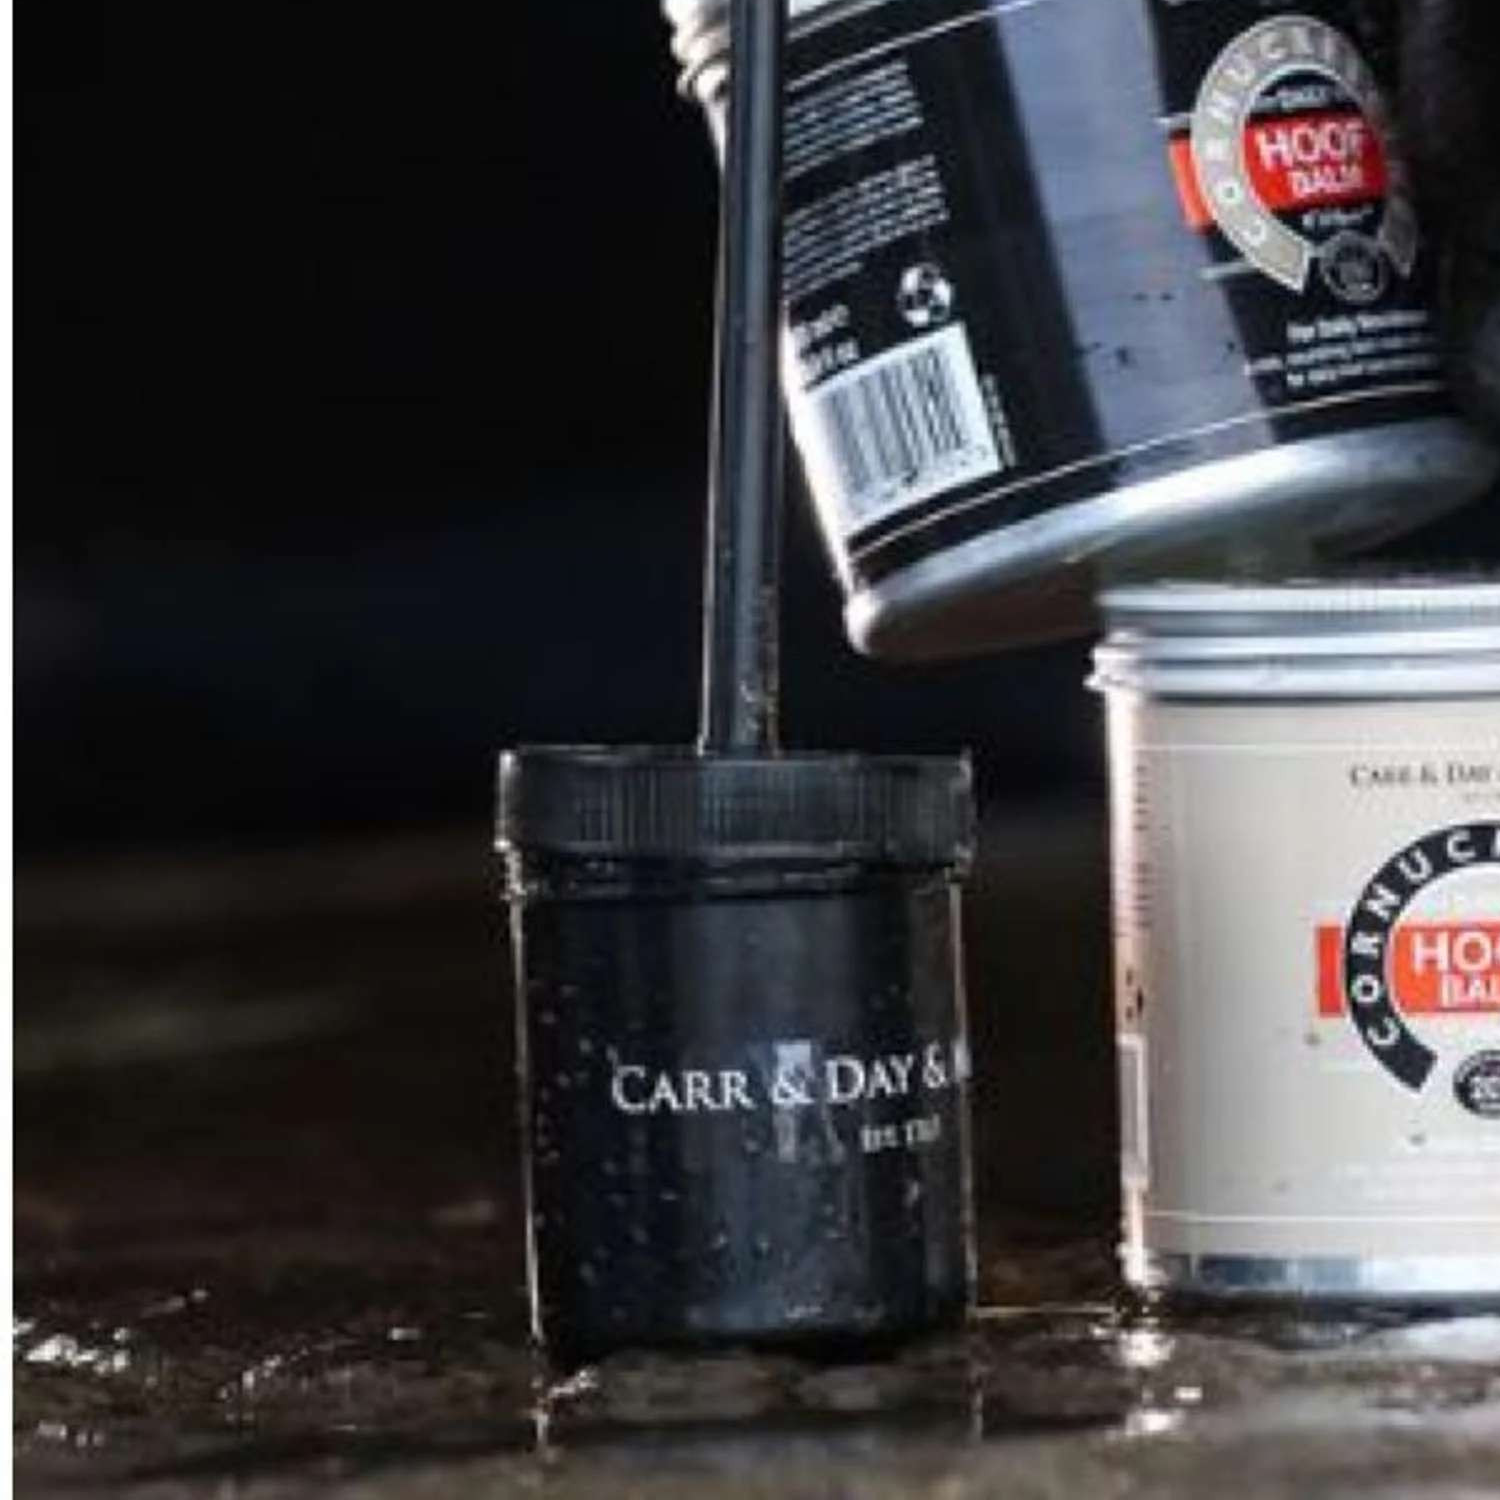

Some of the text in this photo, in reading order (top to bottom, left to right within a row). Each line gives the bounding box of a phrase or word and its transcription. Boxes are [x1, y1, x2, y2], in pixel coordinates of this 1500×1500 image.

[1255, 116, 1364, 172] HOOF
[1287, 162, 1364, 199] BALM
[611, 1064, 754, 1114] CARR
[772, 1058, 814, 1105] &
[826, 1053, 914, 1105] DAY
[922, 1040, 948, 1090] &
